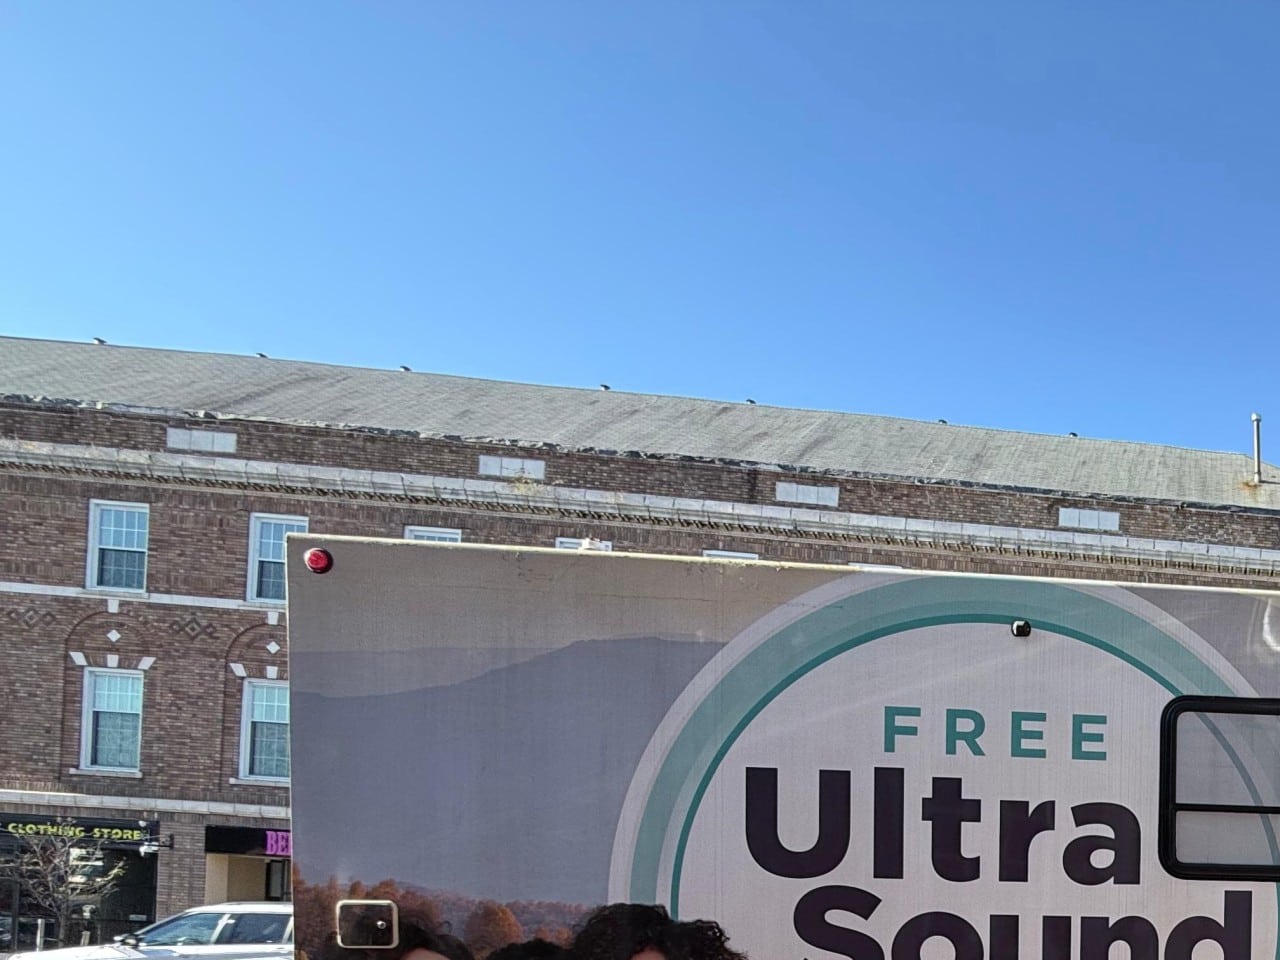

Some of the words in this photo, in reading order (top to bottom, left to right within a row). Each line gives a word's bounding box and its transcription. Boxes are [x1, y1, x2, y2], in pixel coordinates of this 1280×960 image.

[883, 705, 1108, 761] FREE
[8, 822, 85, 837] CLOTHING
[93, 827, 142, 841] STORE
[265, 830, 292, 856] BE
[745, 766, 1142, 886] Ultra
